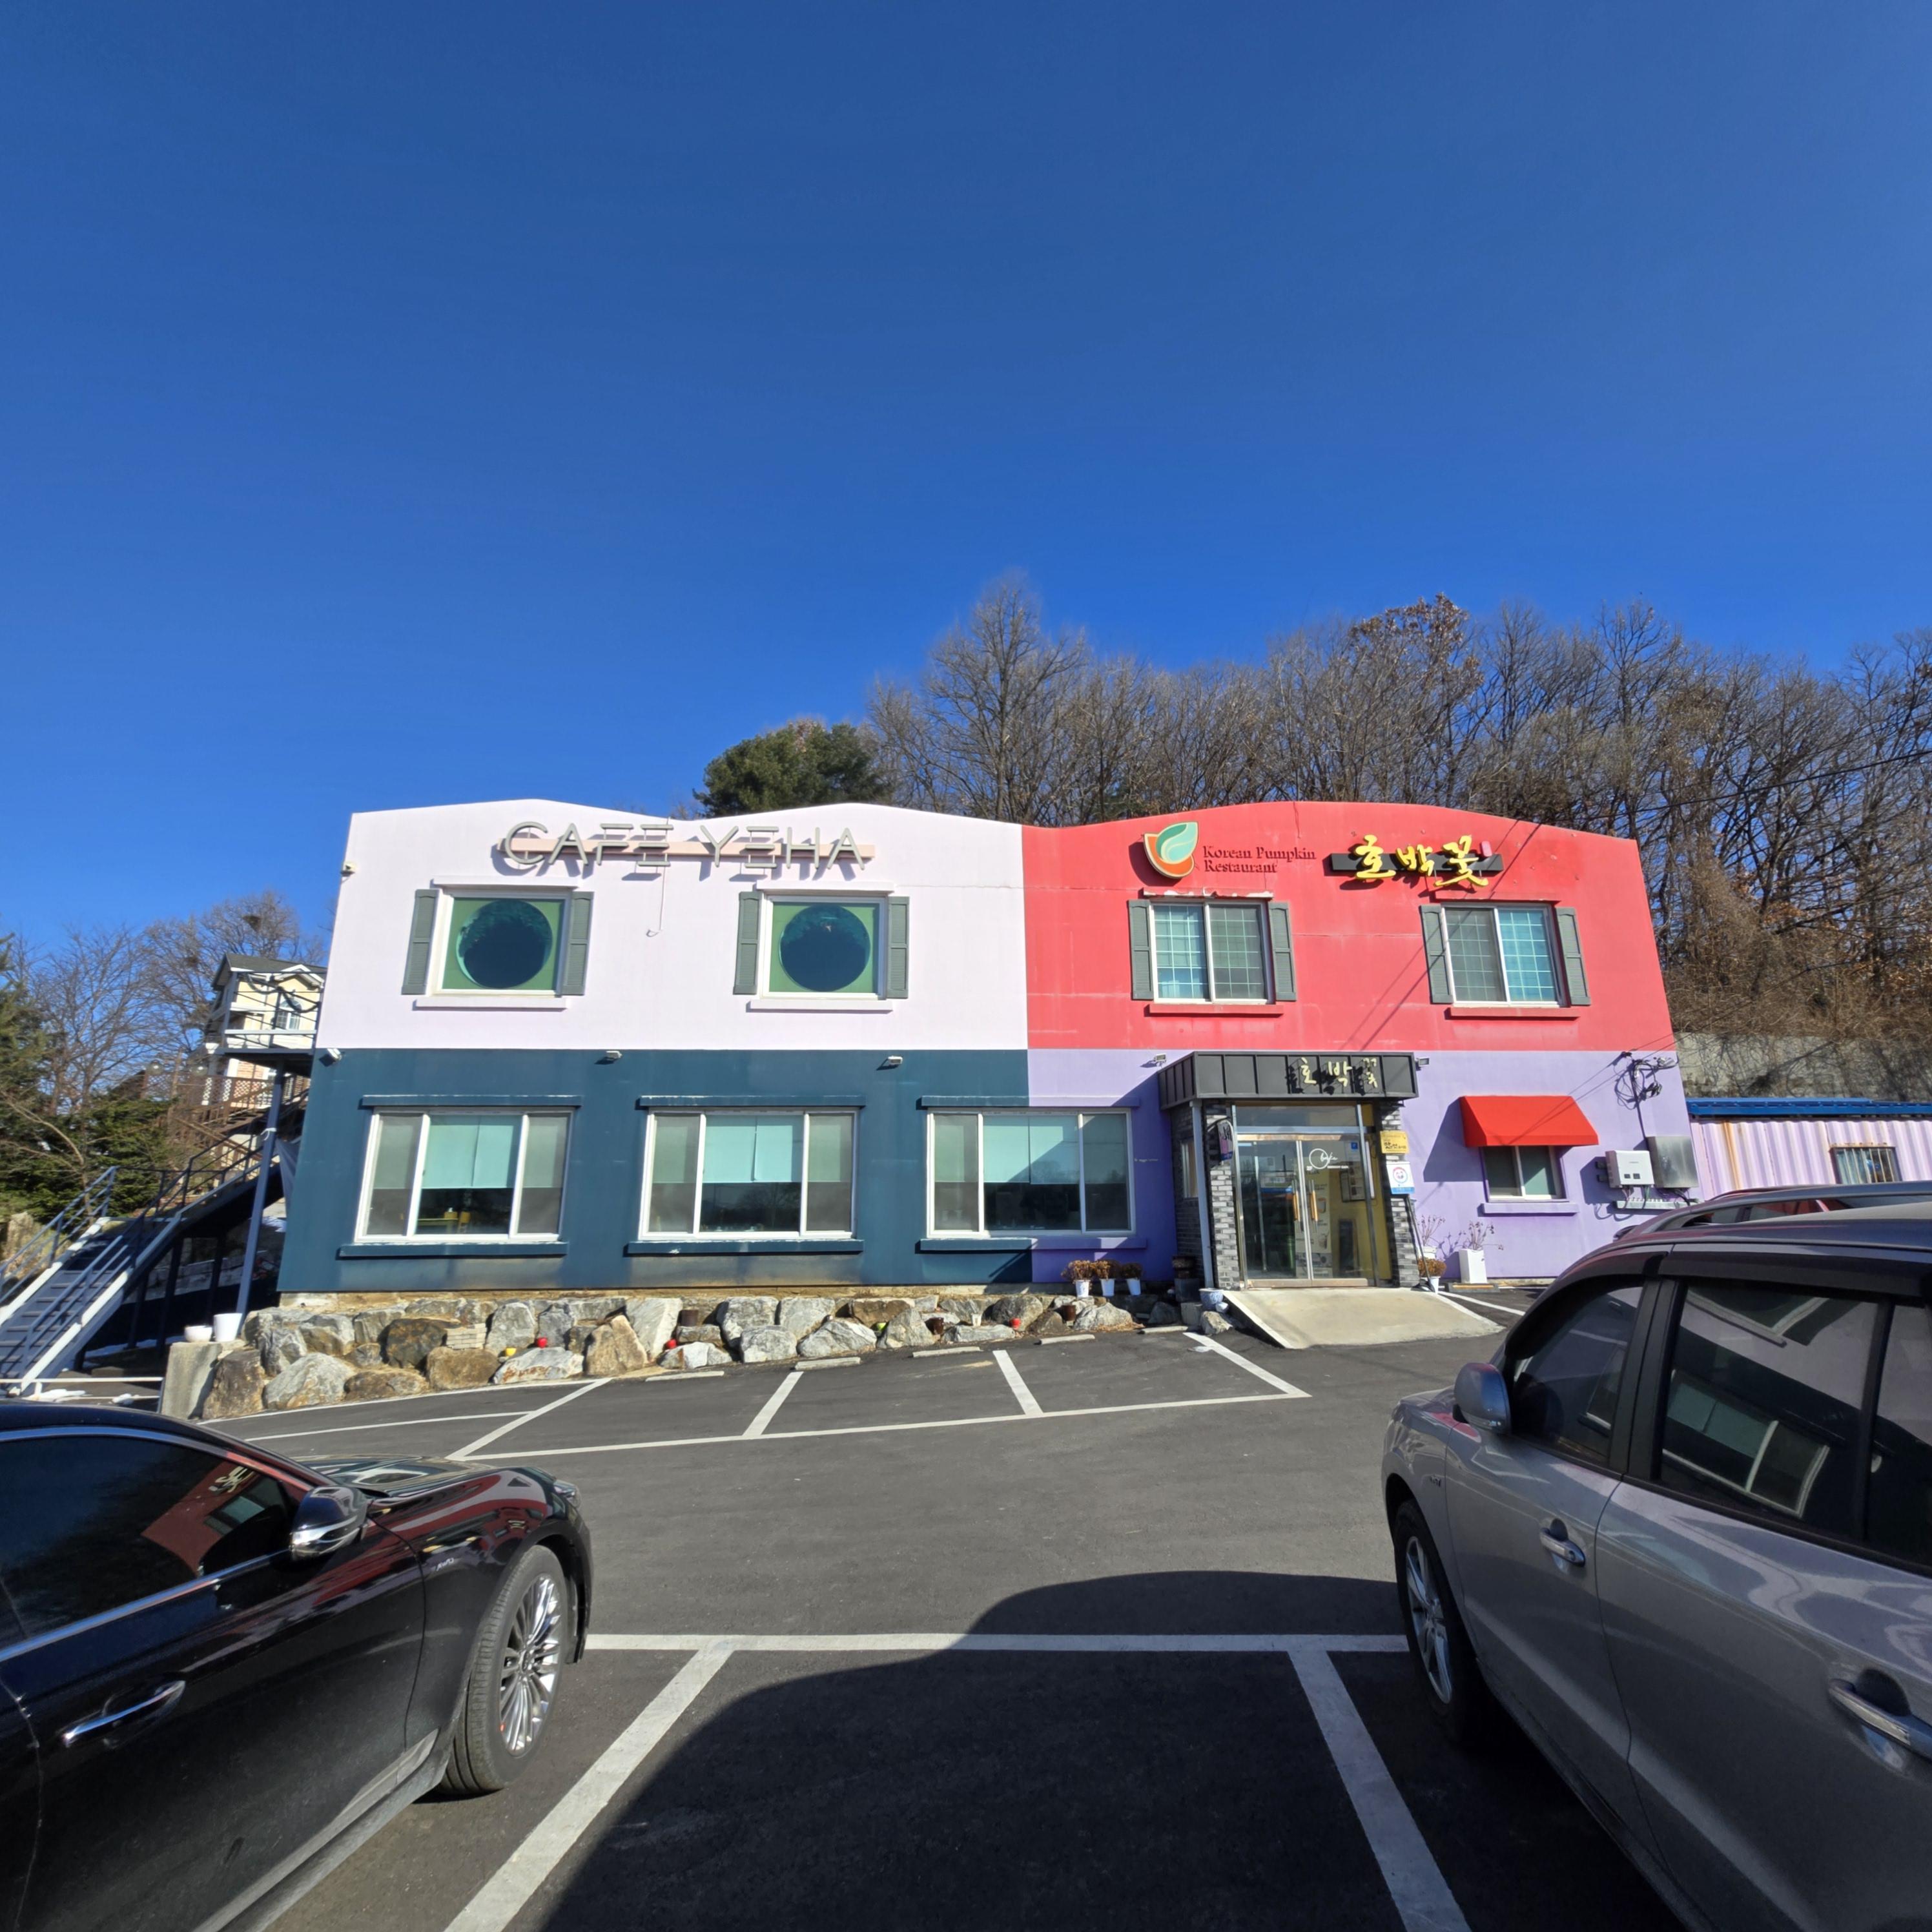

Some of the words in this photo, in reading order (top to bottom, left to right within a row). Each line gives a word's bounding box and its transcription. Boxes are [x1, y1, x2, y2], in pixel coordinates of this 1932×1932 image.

[504, 821, 673, 866] CAFE
[700, 825, 865, 870] YEHA
[1203, 845, 1253, 859] Korean
[1256, 847, 1317, 863] Pumpkin
[1354, 834, 1489, 887] 호박꽃
[1204, 859, 1277, 873] Restaurant
